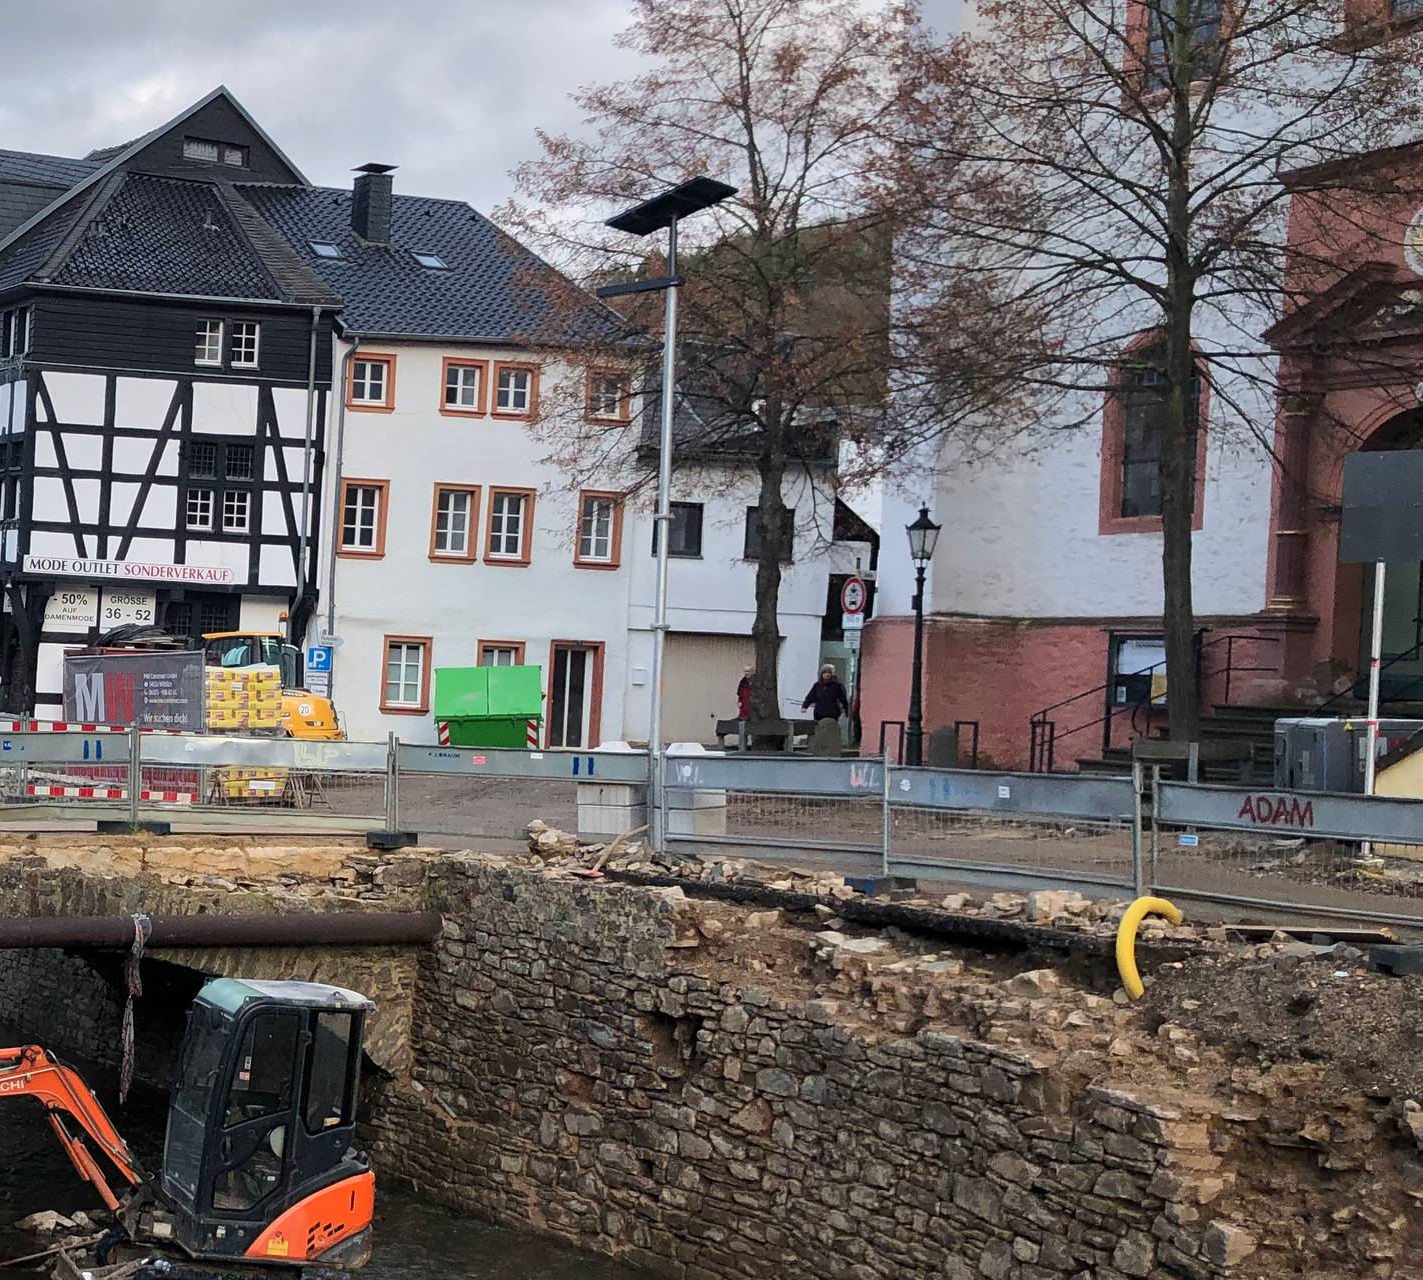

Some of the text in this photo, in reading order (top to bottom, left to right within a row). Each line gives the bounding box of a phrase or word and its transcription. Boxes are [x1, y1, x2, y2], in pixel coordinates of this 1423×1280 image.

[28, 558, 229, 582] MODE OUTLET SONDERVERKAUF
[61, 593, 88, 606] 50%
[45, 614, 94, 622] DAMENMODE
[105, 607, 122, 619] 36
[135, 609, 151, 621] 52
[313, 650, 326, 668] P
[300, 705, 310, 715] 20
[1238, 795, 1294, 828] ADAM
